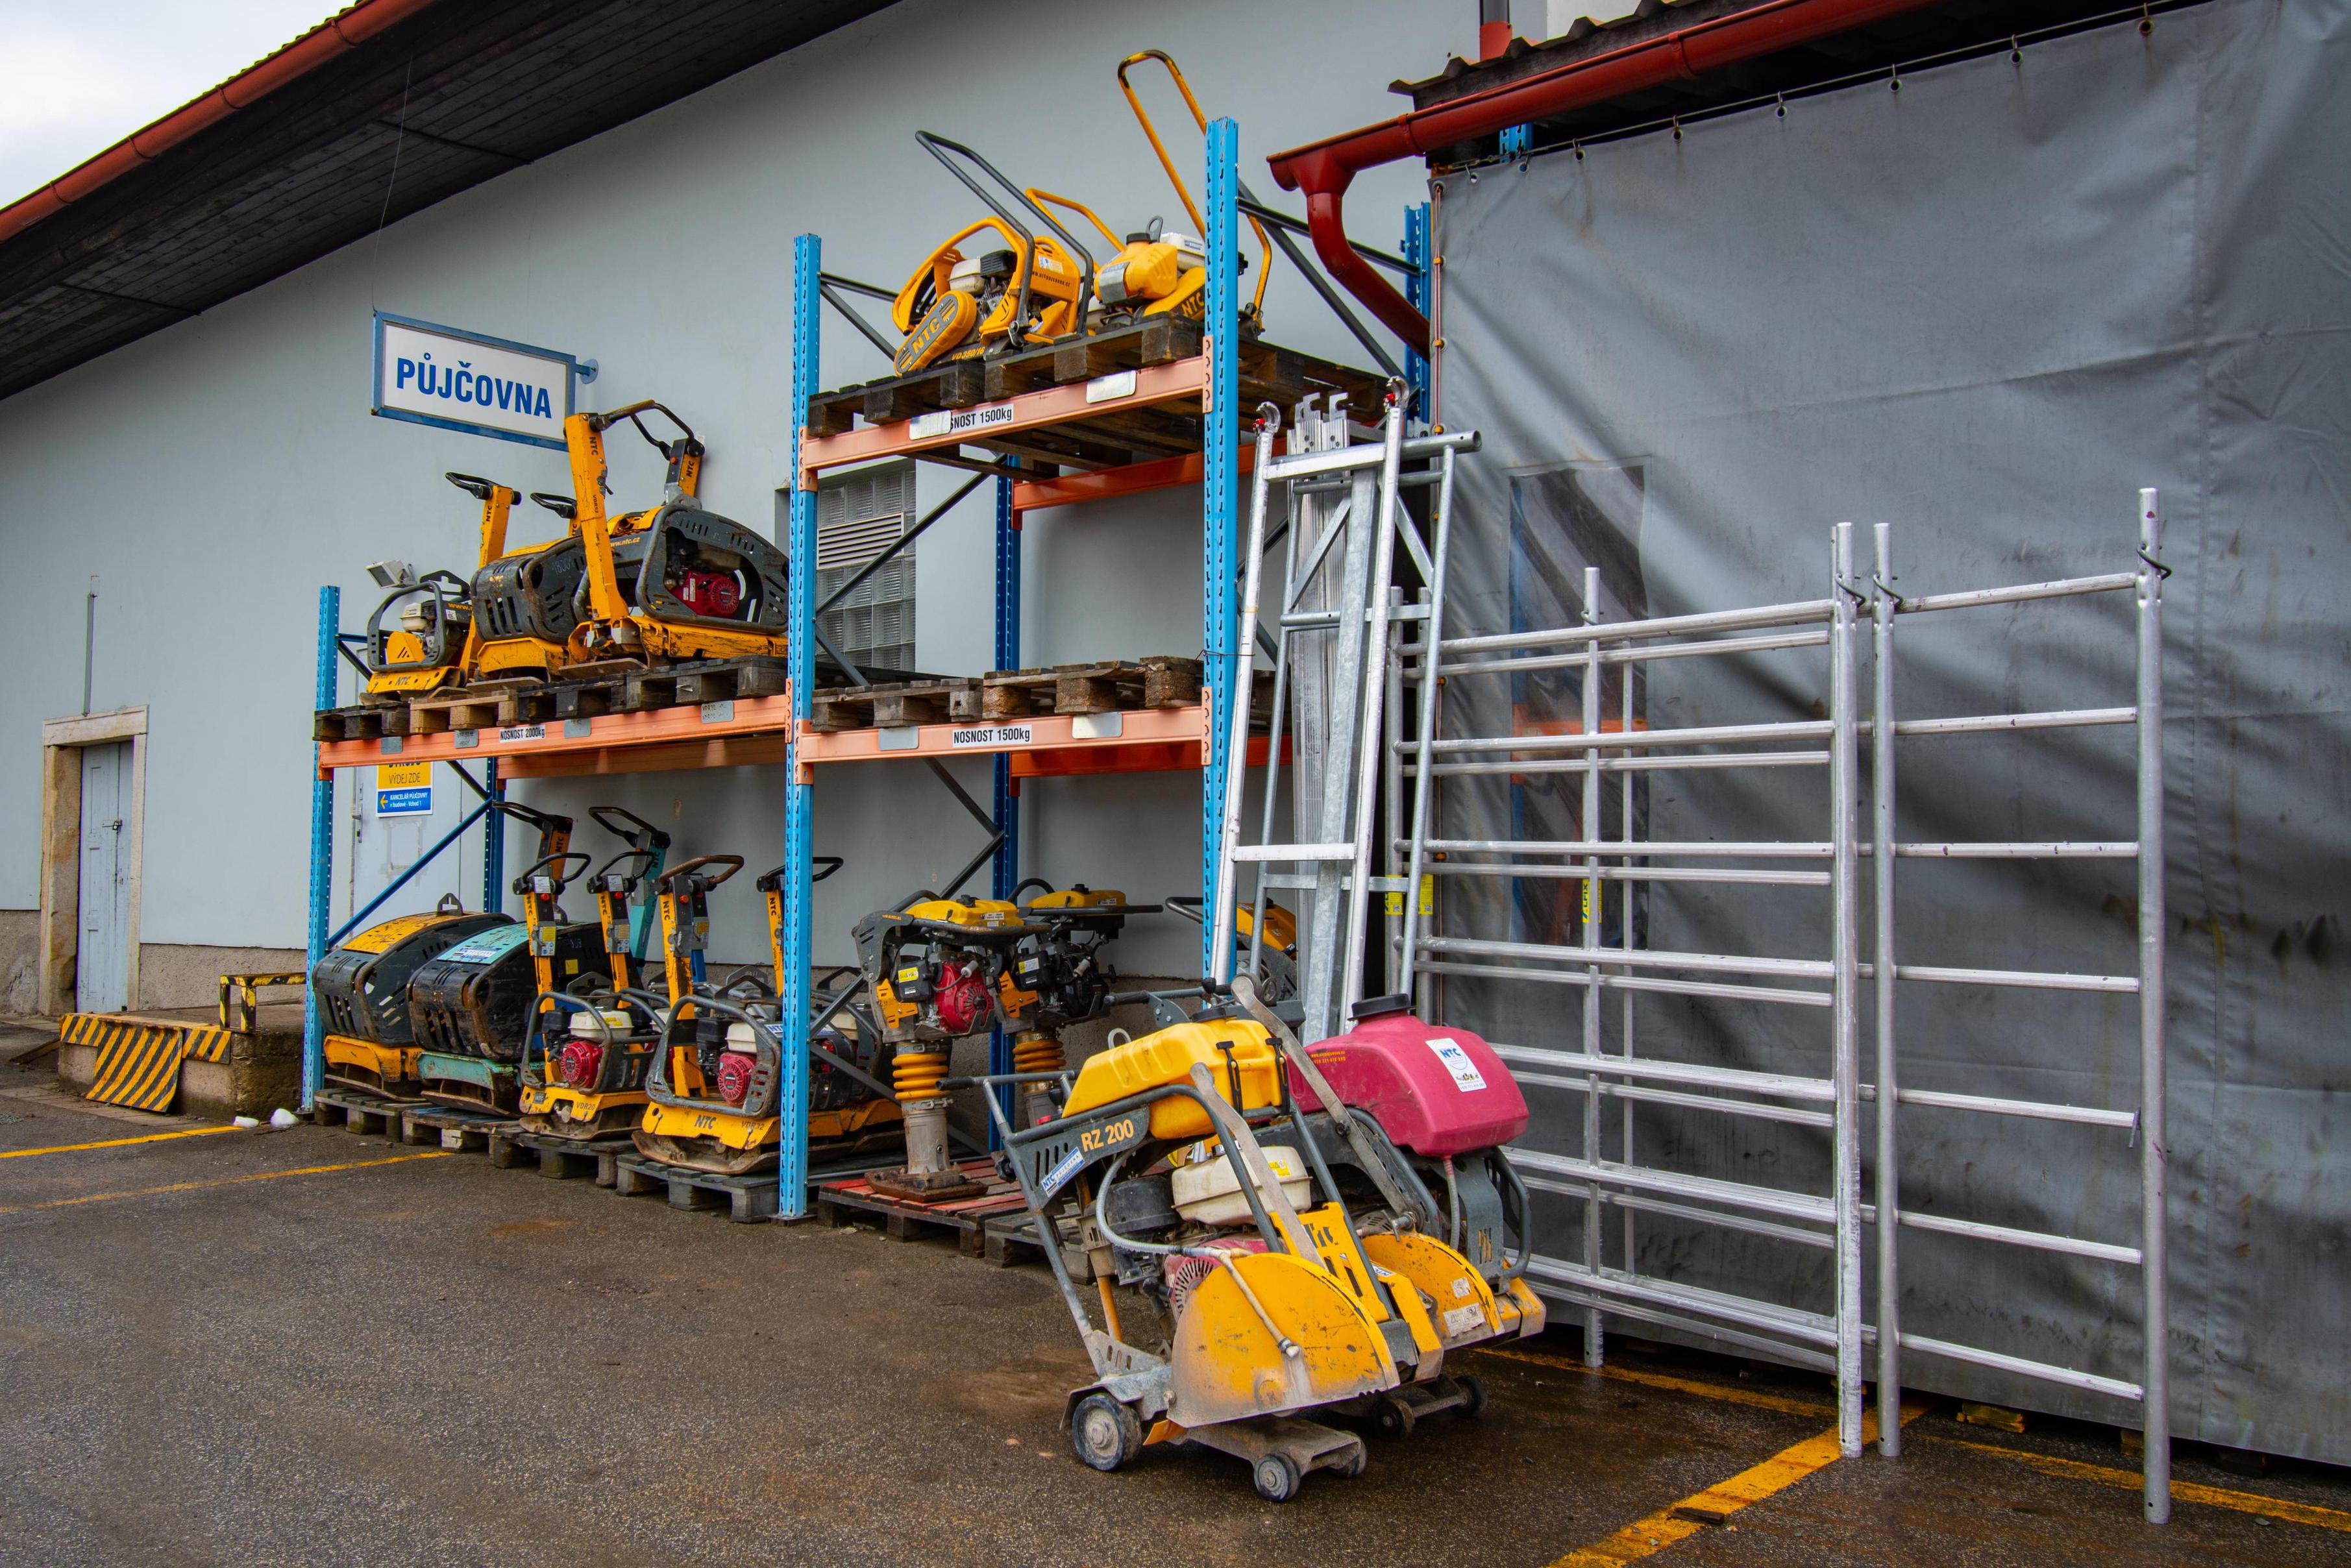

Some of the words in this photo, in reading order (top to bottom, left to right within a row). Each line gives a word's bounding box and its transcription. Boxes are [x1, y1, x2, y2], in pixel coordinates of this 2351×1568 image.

[1181, 292, 1205, 318] NTC
[911, 317, 941, 354] NTC
[396, 352, 552, 419] PŮJČOVNA
[950, 413, 977, 430] SNOST
[980, 408, 1013, 424] 1500kg
[589, 436, 598, 456] NTC
[686, 460, 695, 478] NTC
[610, 537, 641, 547] ww.ntc.cz
[395, 676, 412, 687] NTC
[500, 729, 524, 741] NOSNOST
[525, 727, 545, 739] 2000kg
[954, 729, 994, 744] NOSNOST
[997, 728, 1030, 742] 1500kg
[389, 773, 408, 784] VÝDEJ
[408, 772, 421, 783] ZDE
[555, 835, 565, 852] NTC
[1439, 1047, 1462, 1059] NTC
[694, 1115, 717, 1130] NTC
[1080, 1128, 1104, 1153] RZ
[1105, 1118, 1135, 1145] 200
[1042, 1173, 1055, 1188] NTC
